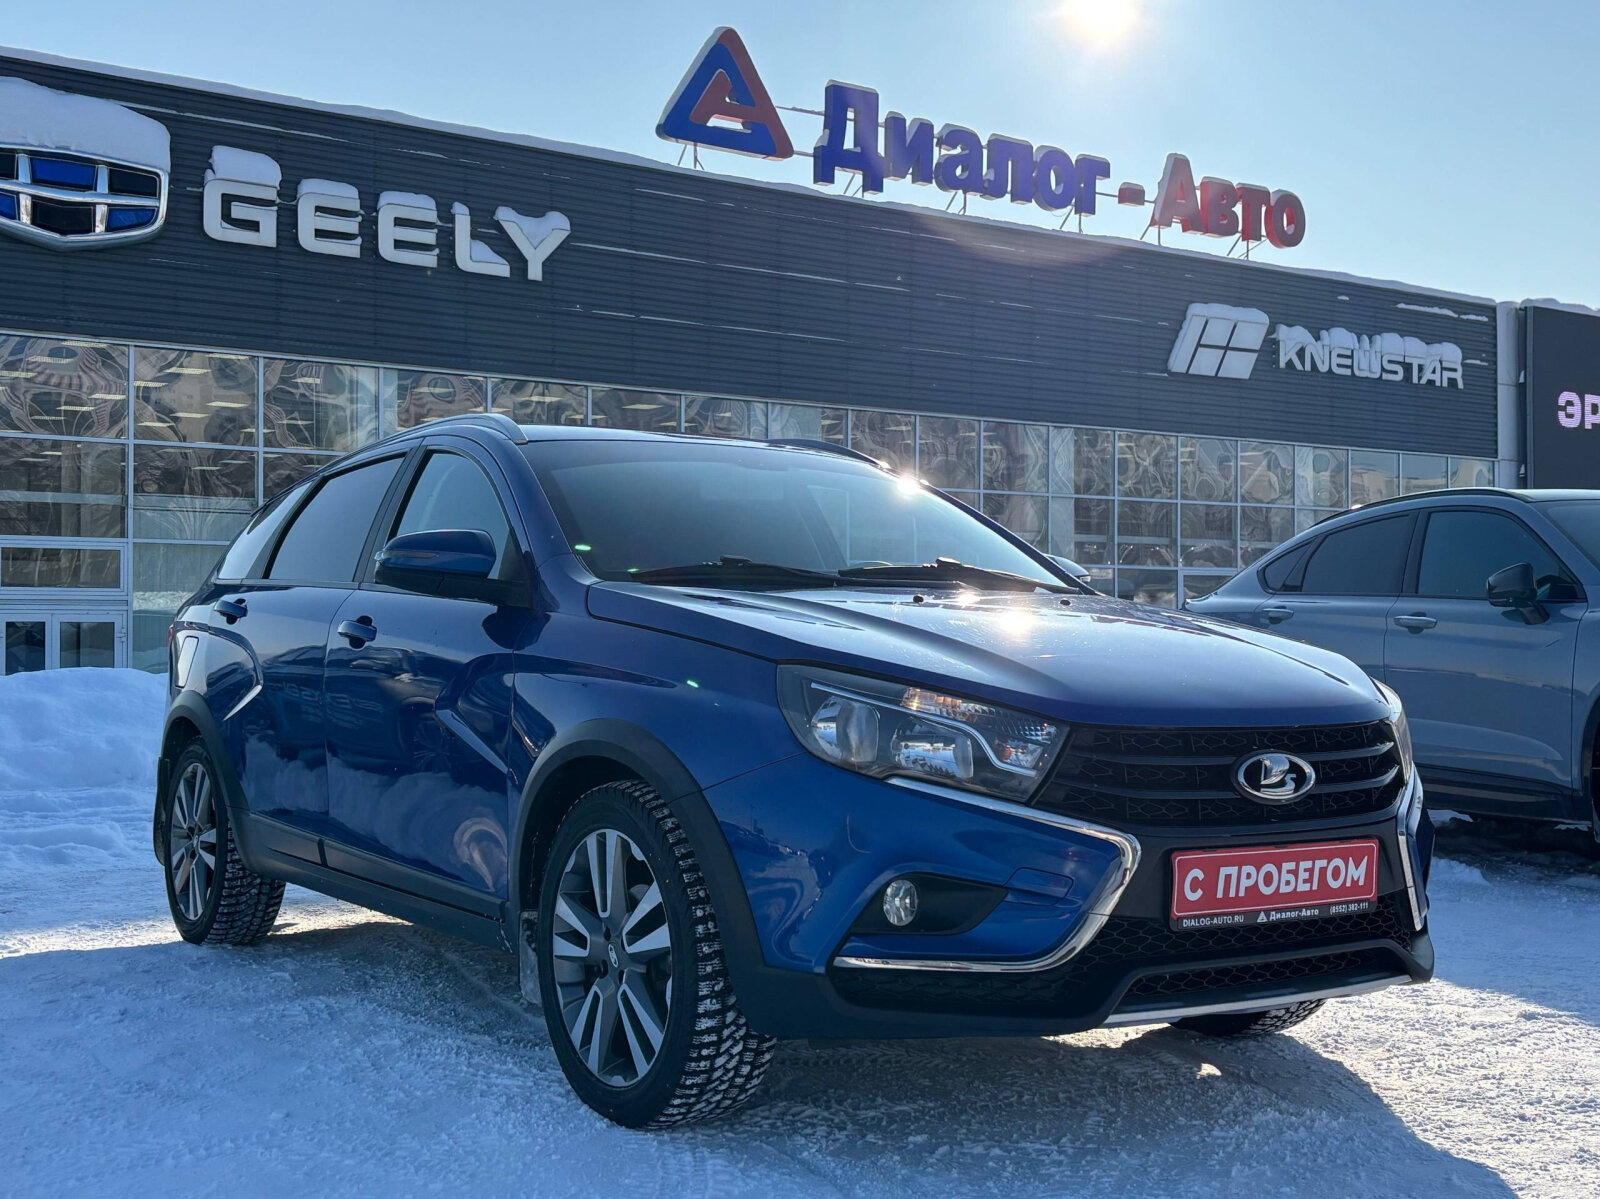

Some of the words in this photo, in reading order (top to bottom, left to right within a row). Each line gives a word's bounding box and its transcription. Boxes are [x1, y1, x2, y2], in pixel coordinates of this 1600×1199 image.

[813, 80, 1306, 249] Диалог-Авто
[203, 176, 571, 282] GEELY
[1278, 339, 1464, 390] KNEWSTAR
[1183, 868, 1205, 901] С
[1216, 855, 1368, 899] ПРОБЕГОМ
[1182, 914, 1245, 928] DIALOG-AUTO.RU
[1269, 908, 1320, 922] Диалог-Авто
